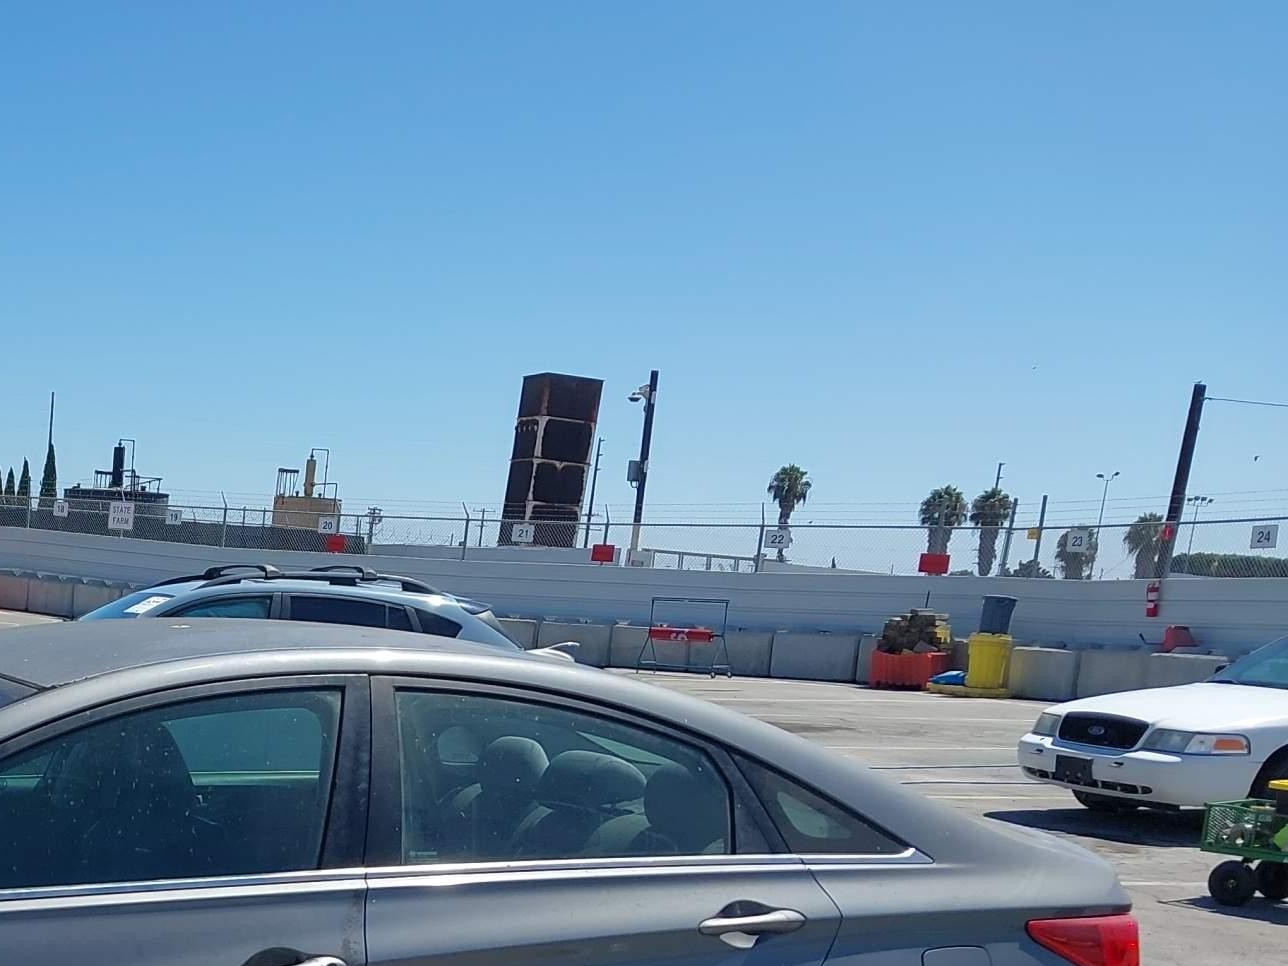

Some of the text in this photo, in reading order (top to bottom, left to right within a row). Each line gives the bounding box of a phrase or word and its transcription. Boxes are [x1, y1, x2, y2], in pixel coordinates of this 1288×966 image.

[57, 504, 65, 514] 18
[112, 505, 131, 514] STATE
[112, 516, 130, 525] FARM
[170, 513, 178, 522] 19
[322, 520, 333, 530] 20
[518, 528, 529, 539] 21
[1256, 530, 1271, 543] 24
[770, 534, 784, 544] 22
[1071, 535, 1083, 547] 23
